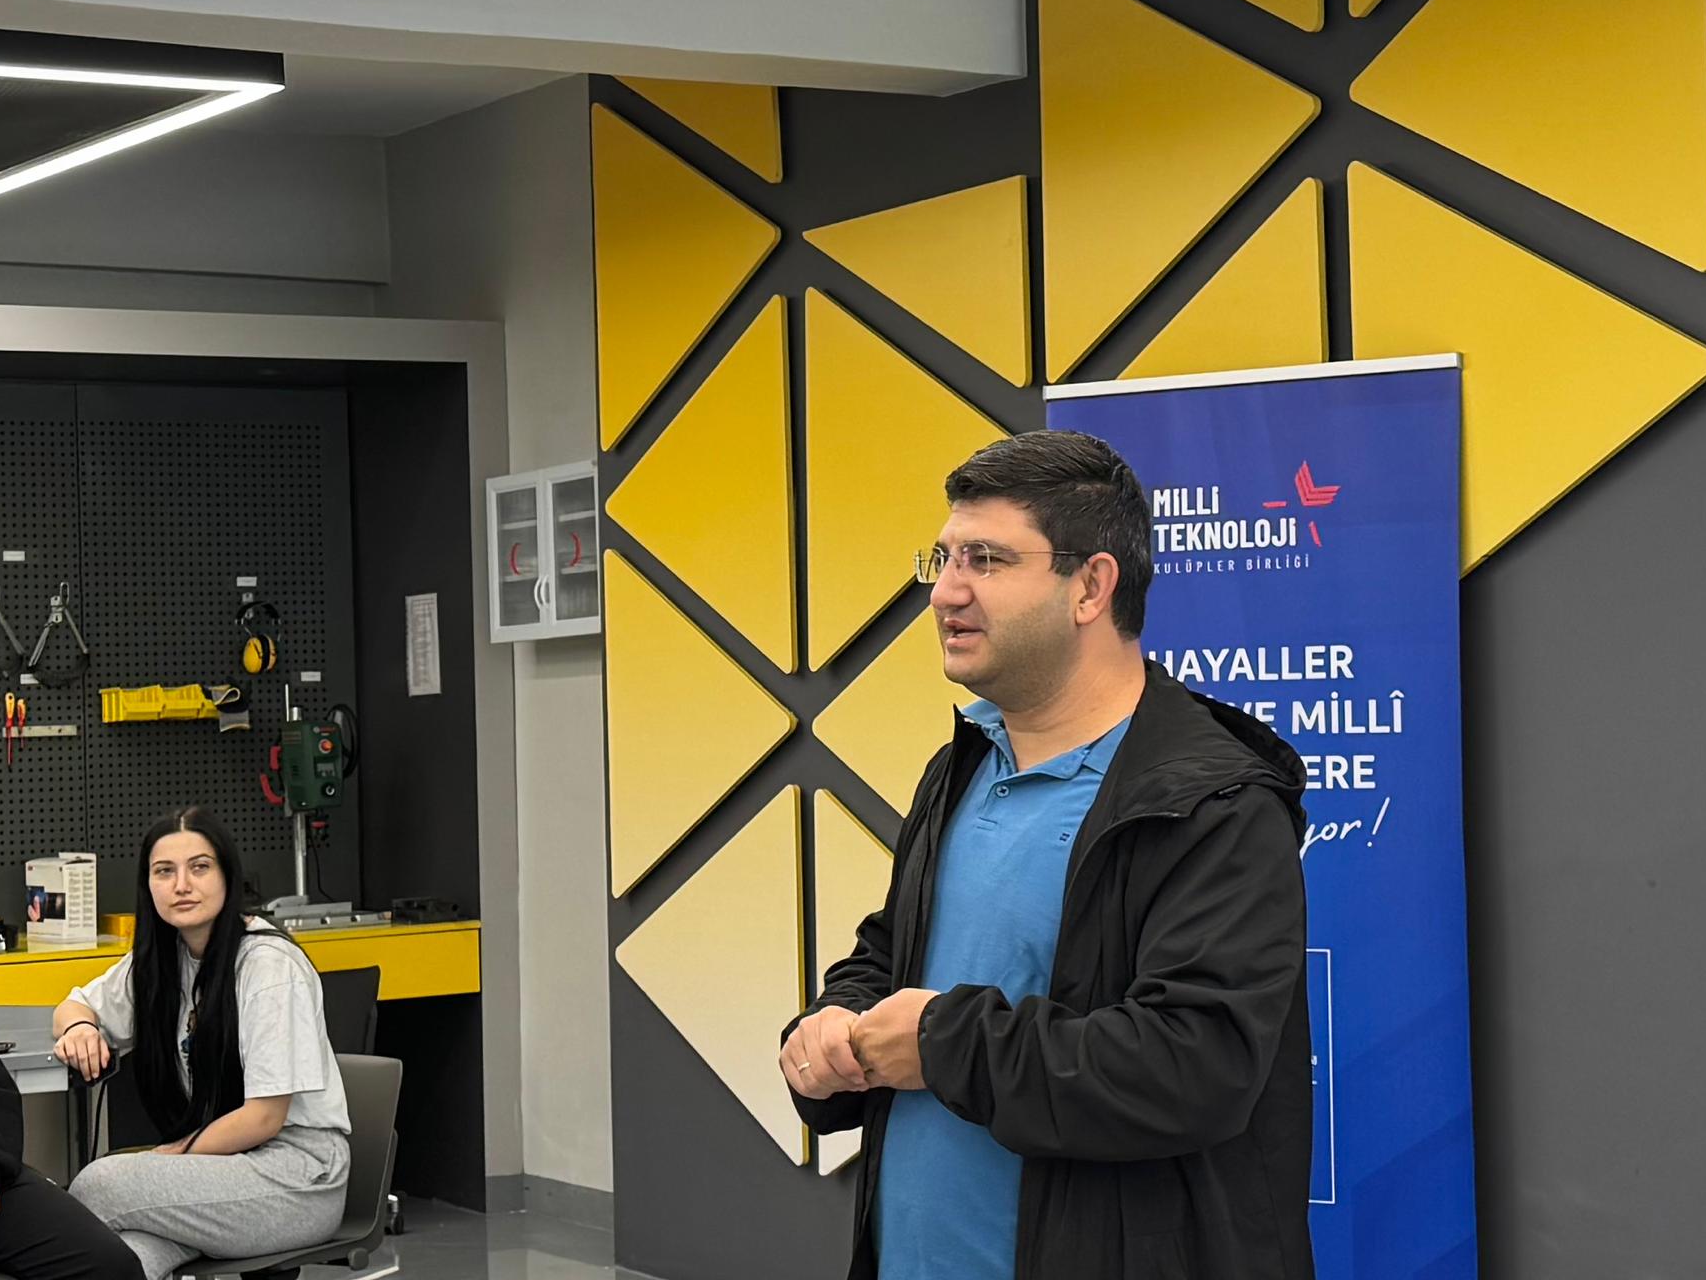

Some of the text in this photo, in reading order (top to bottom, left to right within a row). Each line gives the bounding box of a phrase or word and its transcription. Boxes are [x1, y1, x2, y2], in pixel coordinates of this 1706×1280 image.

[1153, 486, 1220, 518] MİLLİ
[1153, 517, 1297, 553] TEKNOLOJİ
[1154, 553, 1310, 575] KULÜPLER BİRLİĞİ
[1291, 689, 1405, 735] MİLLÎ
